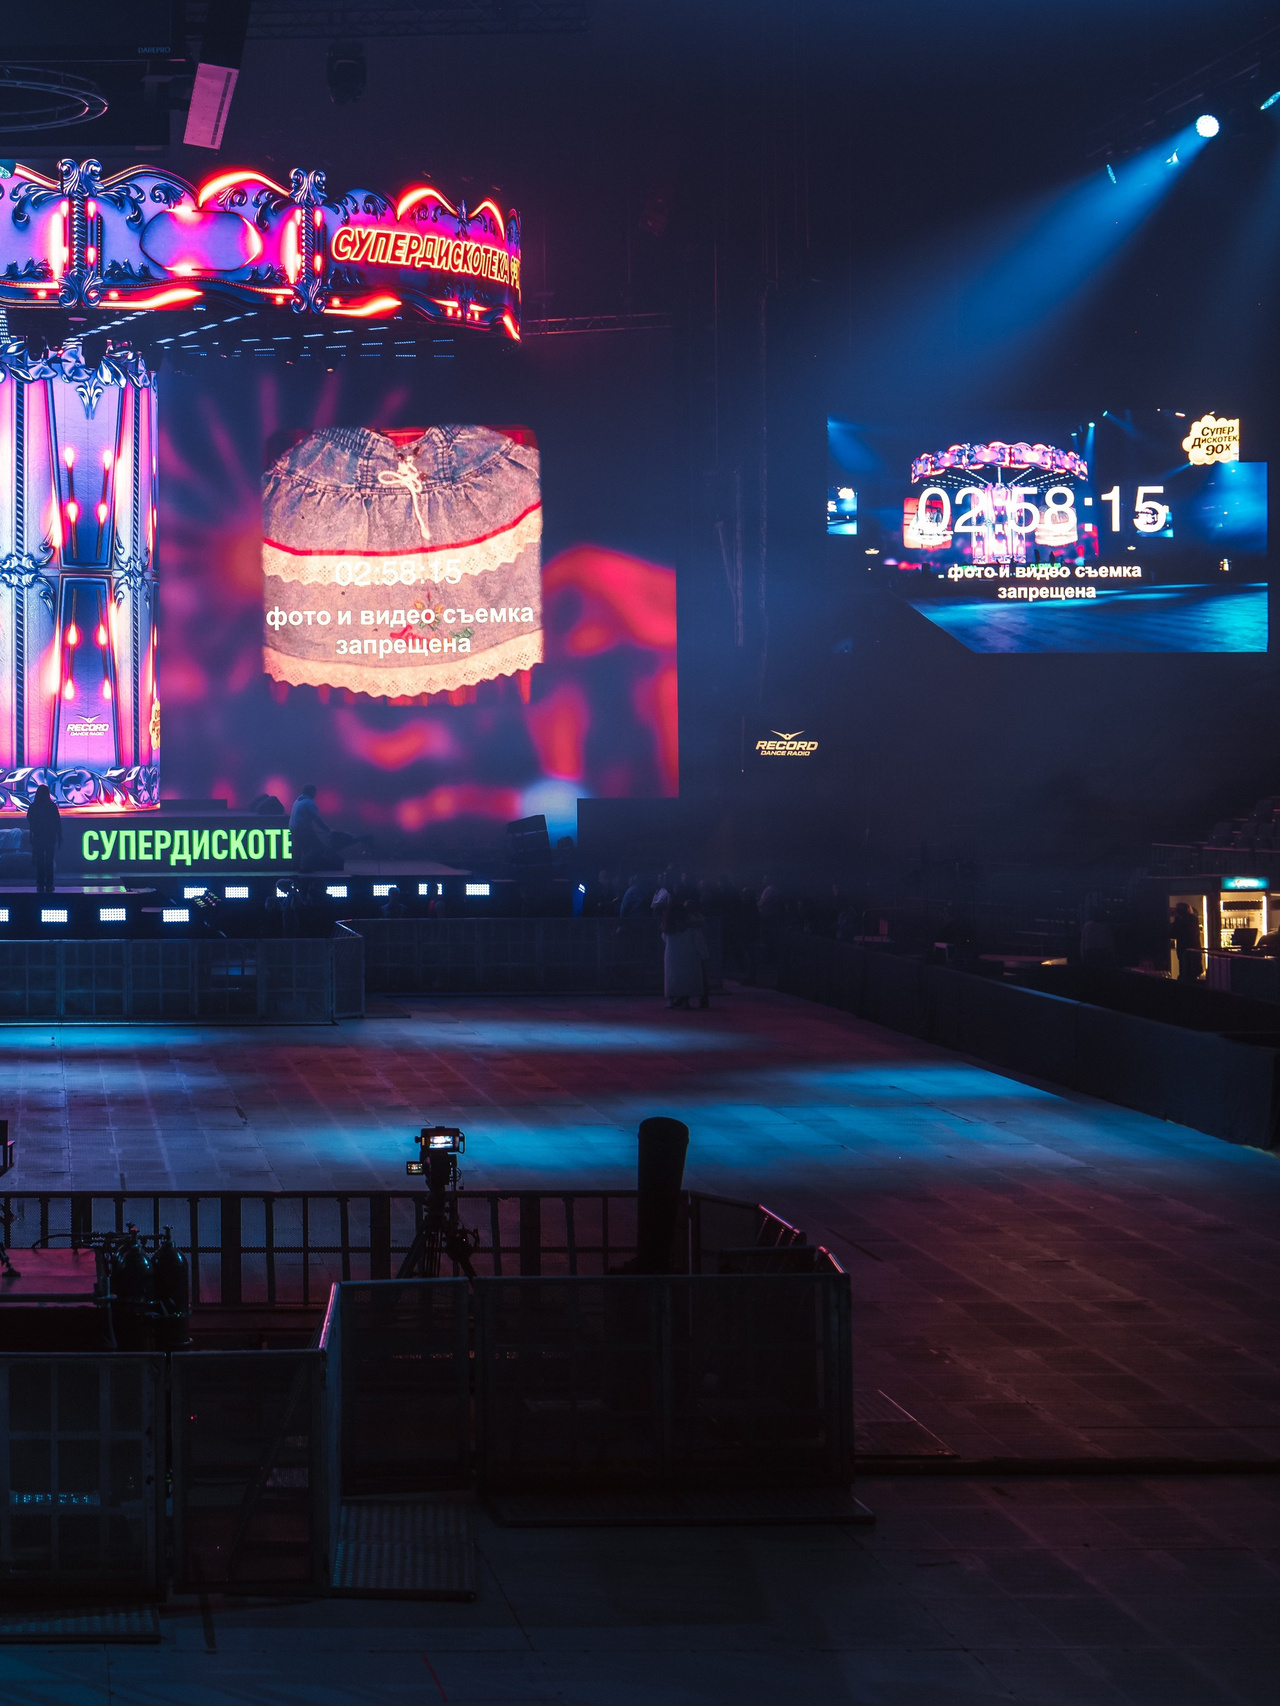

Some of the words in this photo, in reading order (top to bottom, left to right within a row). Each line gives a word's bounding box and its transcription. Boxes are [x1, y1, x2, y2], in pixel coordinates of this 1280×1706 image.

[332, 226, 509, 284] СУПЕРДИСКОТЕКА
[1191, 434, 1240, 449] Дискотек
[918, 485, 1167, 534] 02:58:15
[334, 558, 463, 587] 02:58:15
[947, 564, 996, 582] фото
[999, 565, 1010, 578] и
[1015, 565, 1071, 581] видео
[1075, 564, 1142, 578] съемка
[997, 585, 1096, 602] запрещена
[265, 606, 332, 631] фото
[337, 609, 353, 625] и
[359, 608, 436, 629] видео
[442, 606, 534, 624] съемка
[335, 635, 472, 659] запрещена
[66, 723, 110, 732] RECORD
[755, 740, 819, 751] RECORD
